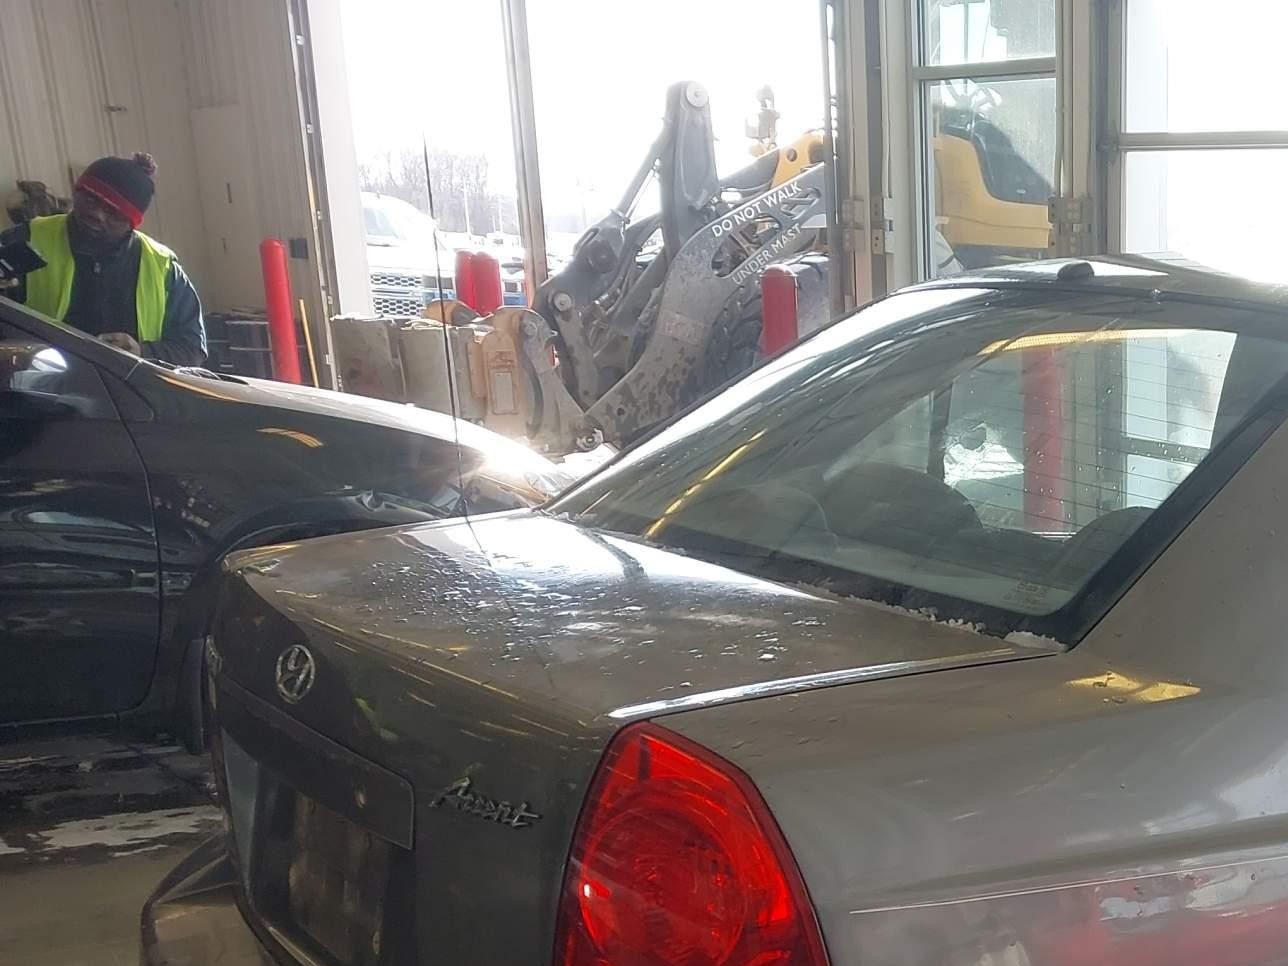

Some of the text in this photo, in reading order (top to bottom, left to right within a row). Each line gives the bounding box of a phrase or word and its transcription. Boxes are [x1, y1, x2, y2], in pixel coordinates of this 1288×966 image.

[711, 182, 802, 238] DO NOT WALK
[732, 223, 802, 285] UNDER MAST
